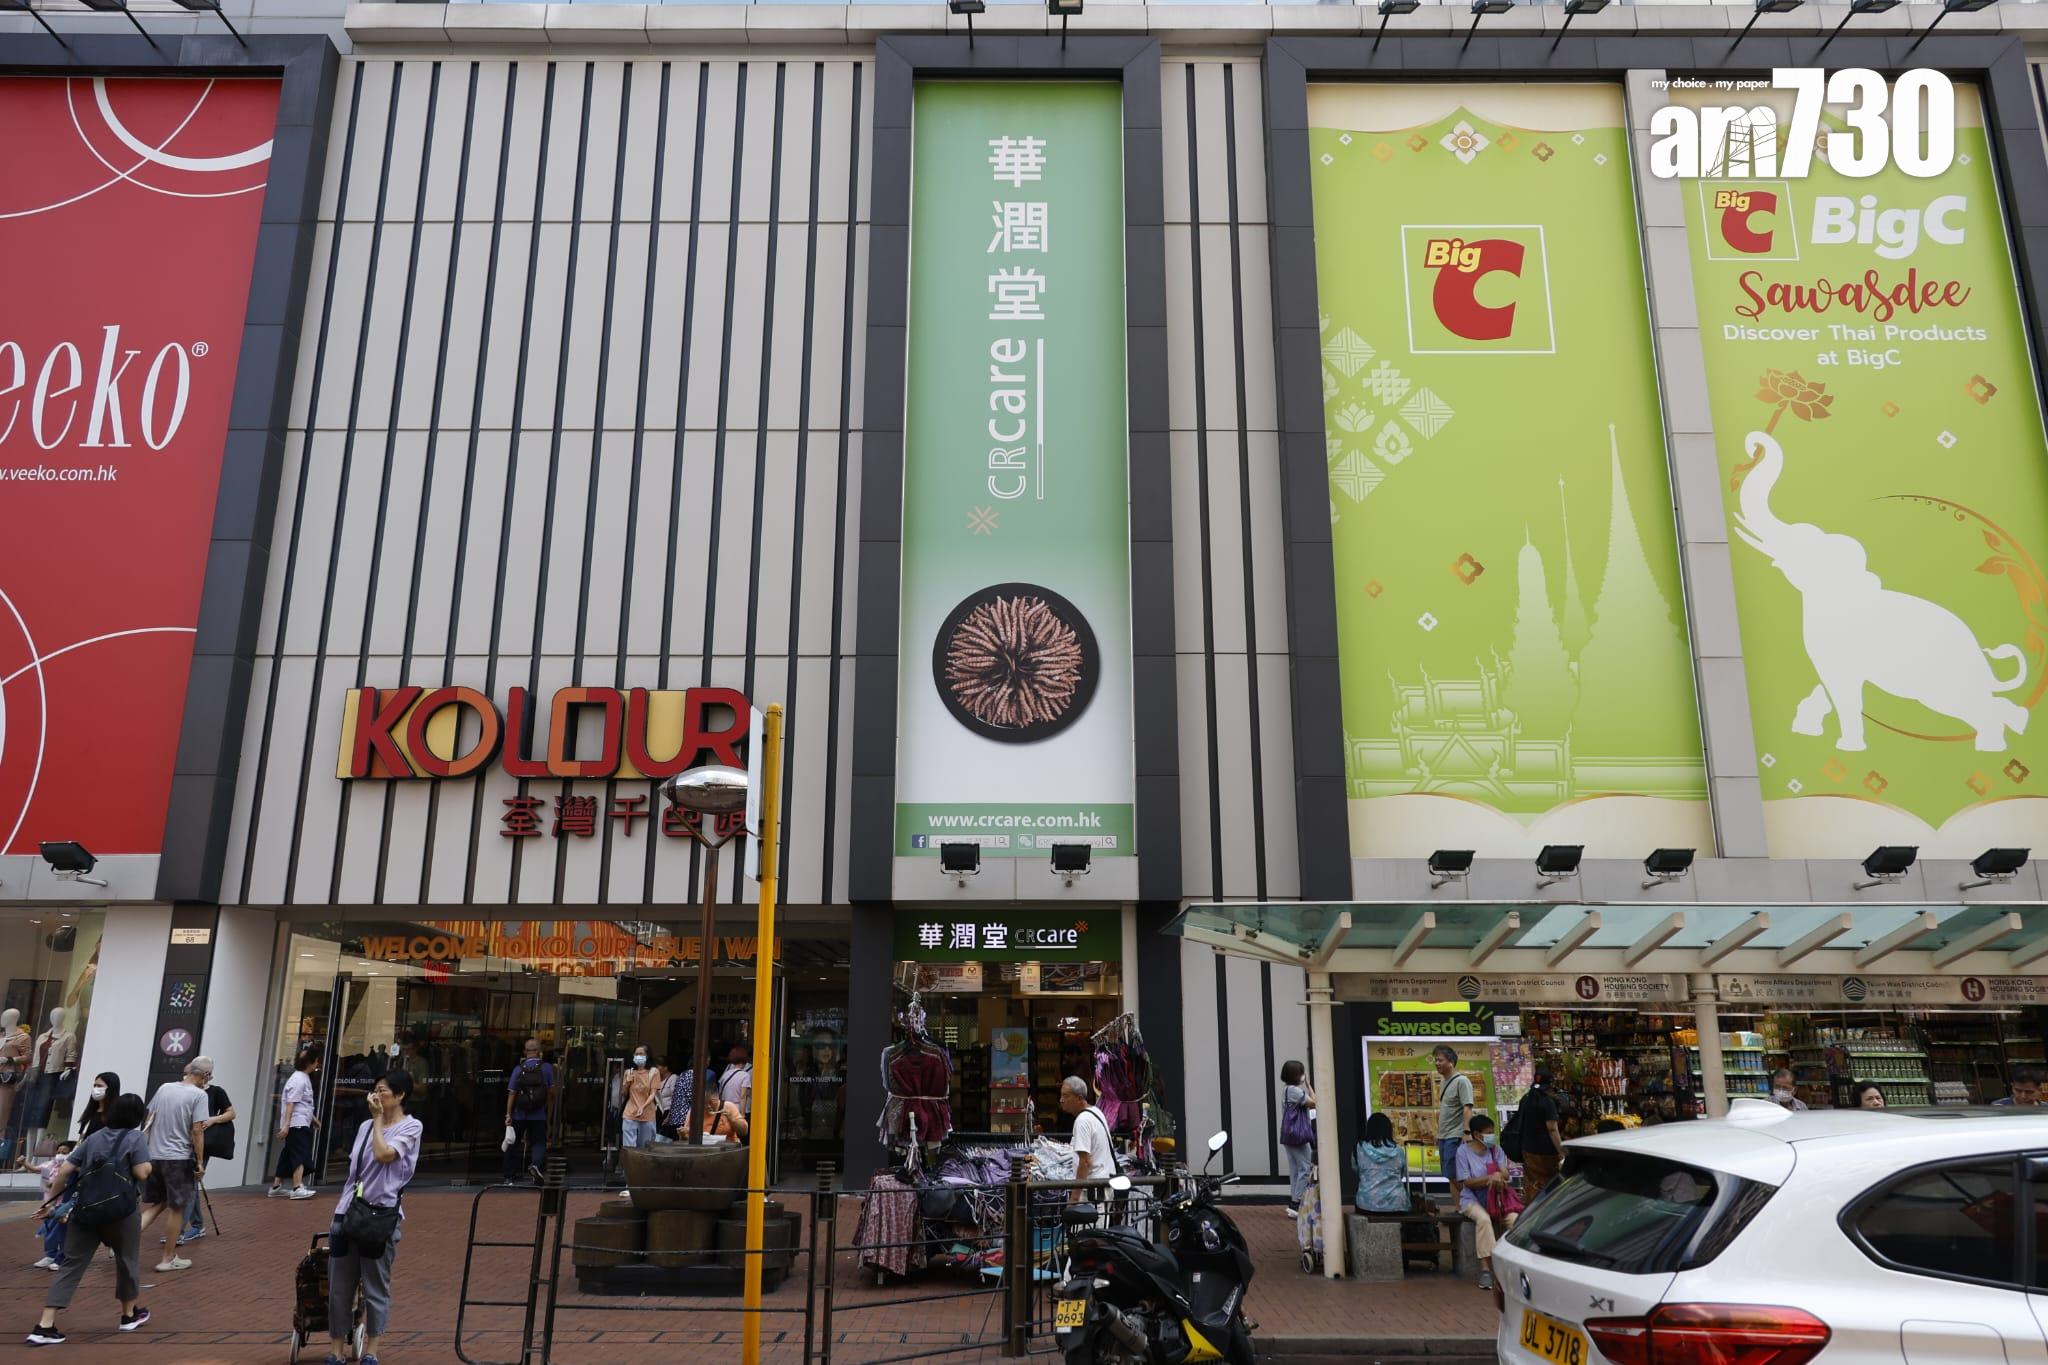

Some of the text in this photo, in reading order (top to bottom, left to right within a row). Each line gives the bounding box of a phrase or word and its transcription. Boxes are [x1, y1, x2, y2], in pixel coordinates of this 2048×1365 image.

[1714, 190, 1751, 211] Big
[987, 135, 1048, 320] 華潤堂
[1810, 195, 1968, 260] BigC
[1424, 238, 1482, 273] Big
[1735, 268, 1971, 322] Sawasdee
[1723, 324, 1987, 342] Discover Thai Products
[1817, 349, 1902, 369] at BigC
[987, 338, 1026, 499] CRcare
[336, 686, 751, 779] KOLOUR
[928, 812, 1101, 828] www.crcare.com.hk
[918, 922, 1008, 949] 華潤堂
[1015, 926, 1077, 944] CRcare
[363, 936, 484, 960] WELCOME
[536, 936, 628, 958] KOLOUR
[1377, 1017, 1482, 1035] Sawasdee
[1590, 1295, 1615, 1312] X1
[1057, 1313, 1083, 1324] 9693
[1545, 1325, 1580, 1365] 3718
